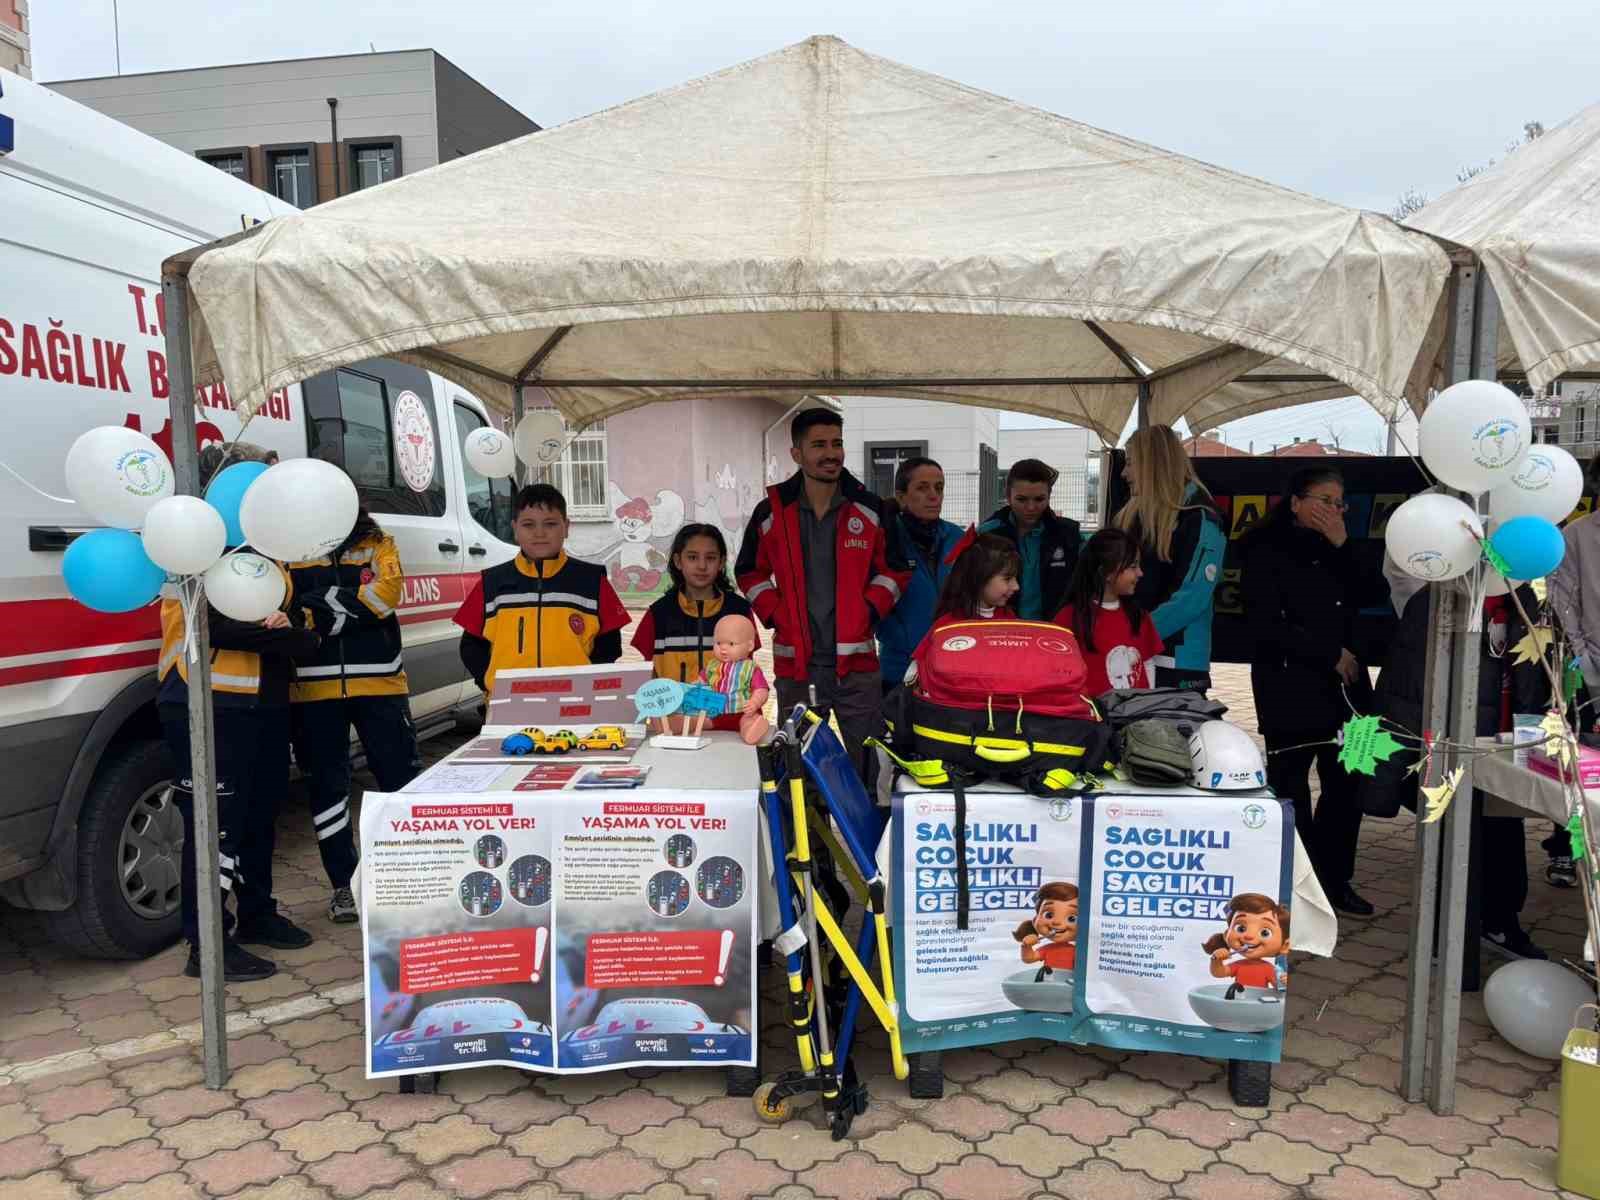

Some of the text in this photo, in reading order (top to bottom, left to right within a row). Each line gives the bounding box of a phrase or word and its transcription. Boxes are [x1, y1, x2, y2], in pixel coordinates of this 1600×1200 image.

[0, 317, 131, 393] SAĞLIK
[416, 806, 458, 816] FERMUAR
[460, 805, 493, 815] SİSTEMİ
[608, 804, 650, 814] FERMUAR
[652, 804, 686, 815] SİSTEMİ
[391, 817, 536, 835] YAŞAMA YOL VER!
[582, 816, 727, 832] YAŞAMA YOL VER!
[919, 890, 1036, 912] GEECEK
[1105, 896, 1228, 919] GELECEK
